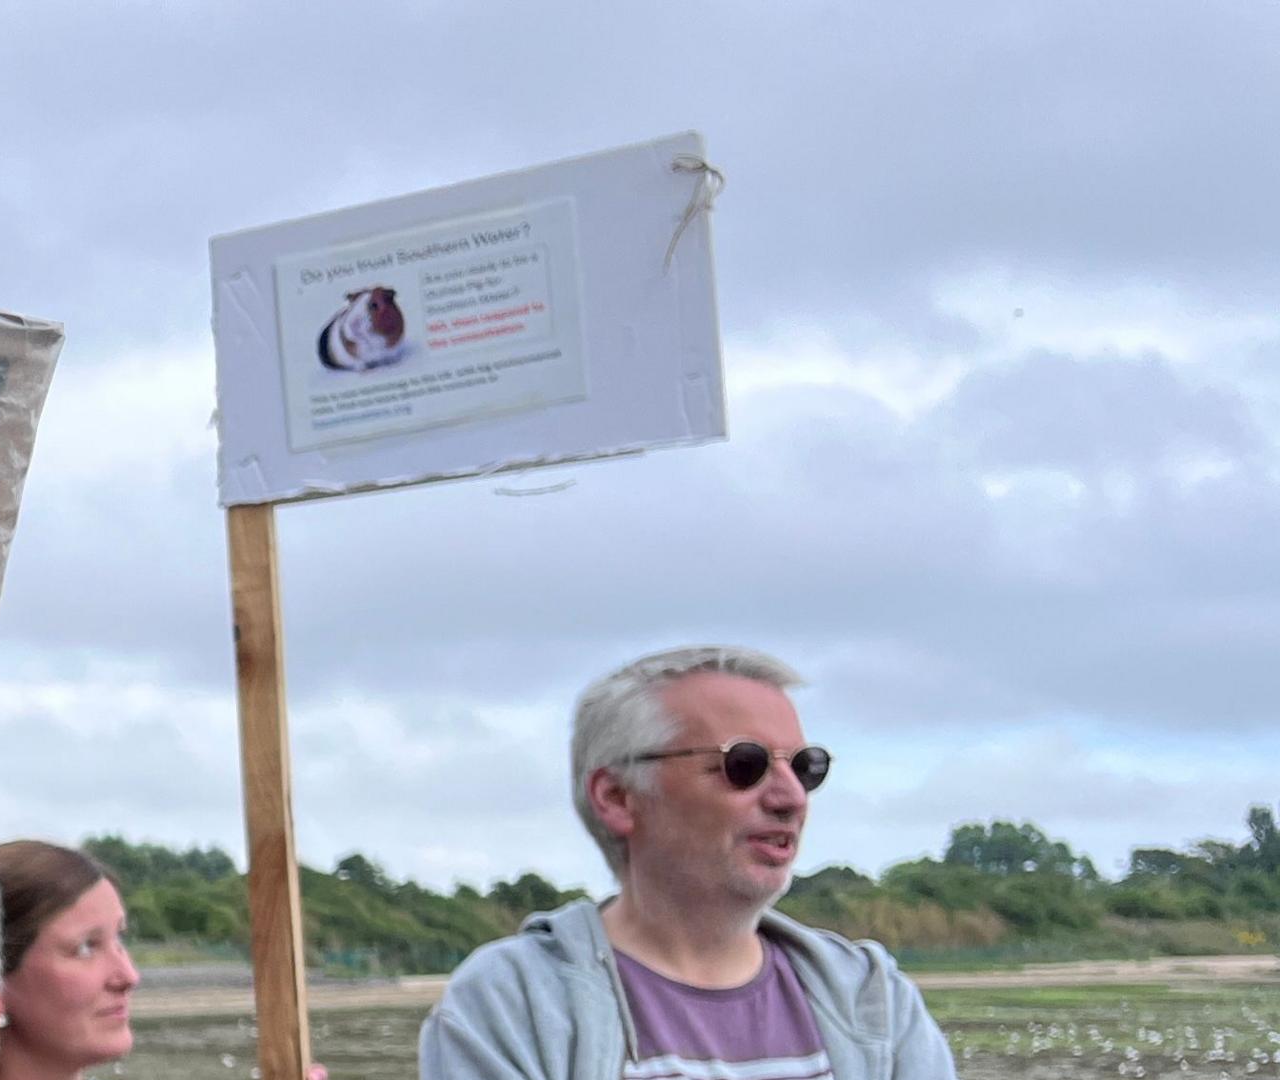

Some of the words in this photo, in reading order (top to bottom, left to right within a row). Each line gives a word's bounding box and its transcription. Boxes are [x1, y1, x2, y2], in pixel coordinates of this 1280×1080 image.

[300, 268, 324, 286] Do
[327, 263, 355, 283] you
[396, 238, 469, 263] Southern
[472, 222, 531, 248] Water?
